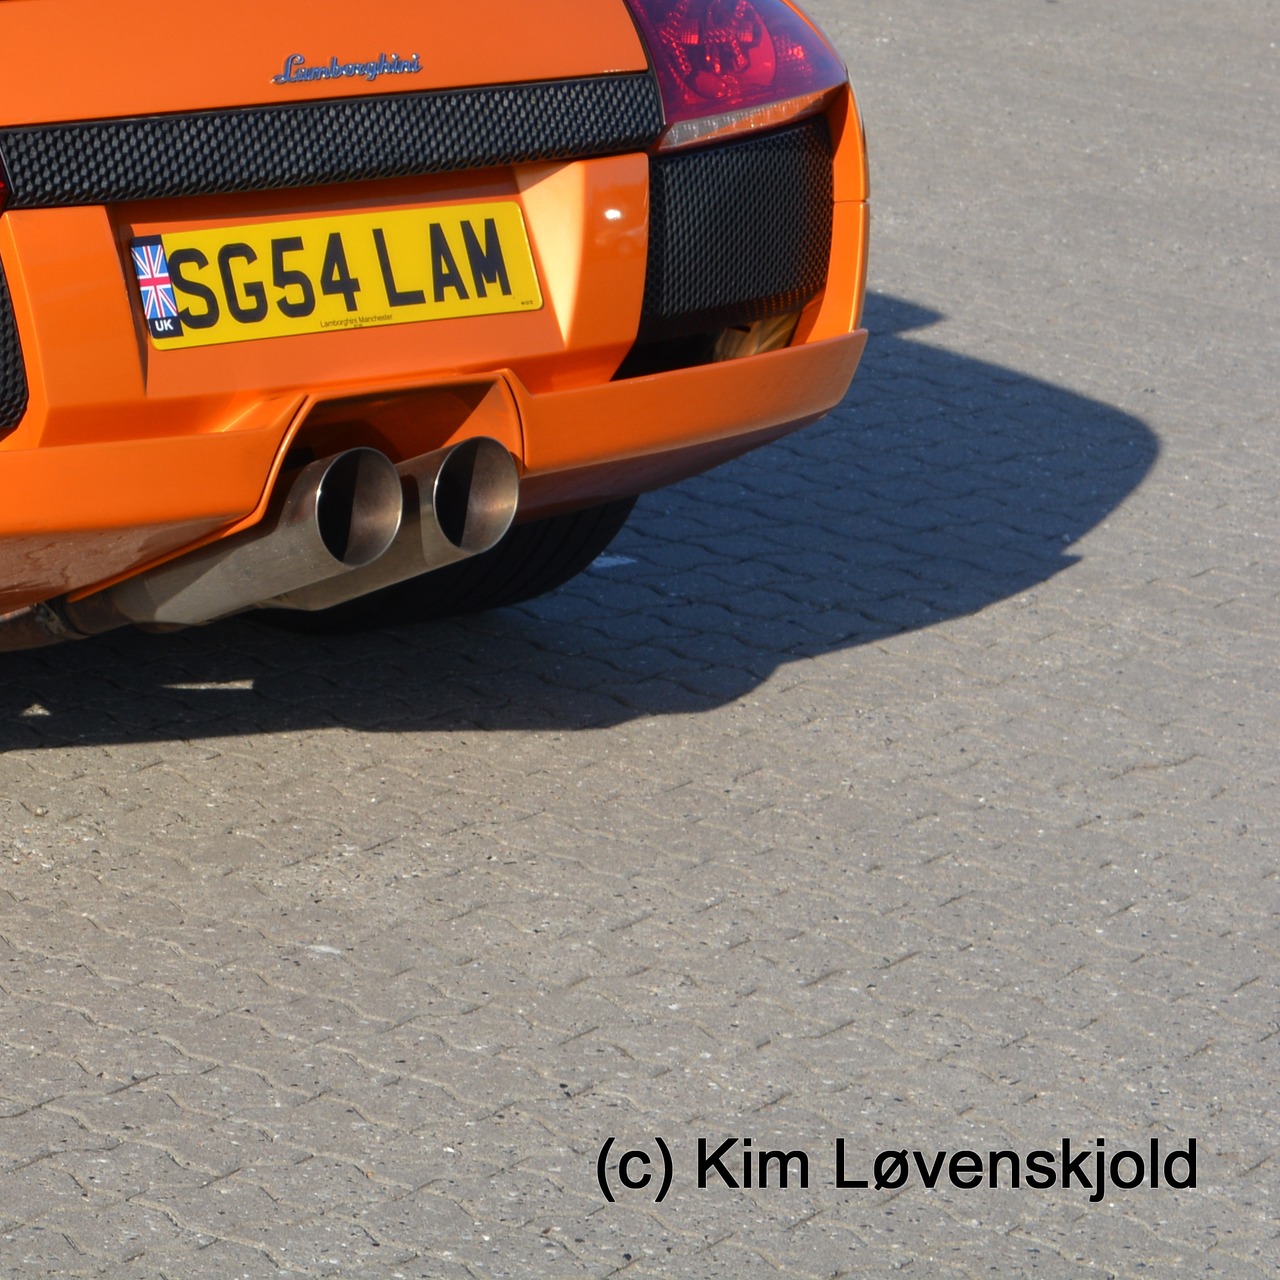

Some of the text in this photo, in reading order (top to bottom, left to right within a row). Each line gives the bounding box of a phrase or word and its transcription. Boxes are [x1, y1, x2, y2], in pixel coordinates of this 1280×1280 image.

[270, 53, 423, 84] Lamborghini
[167, 218, 512, 329] SG54 LAM
[154, 318, 174, 333] UK
